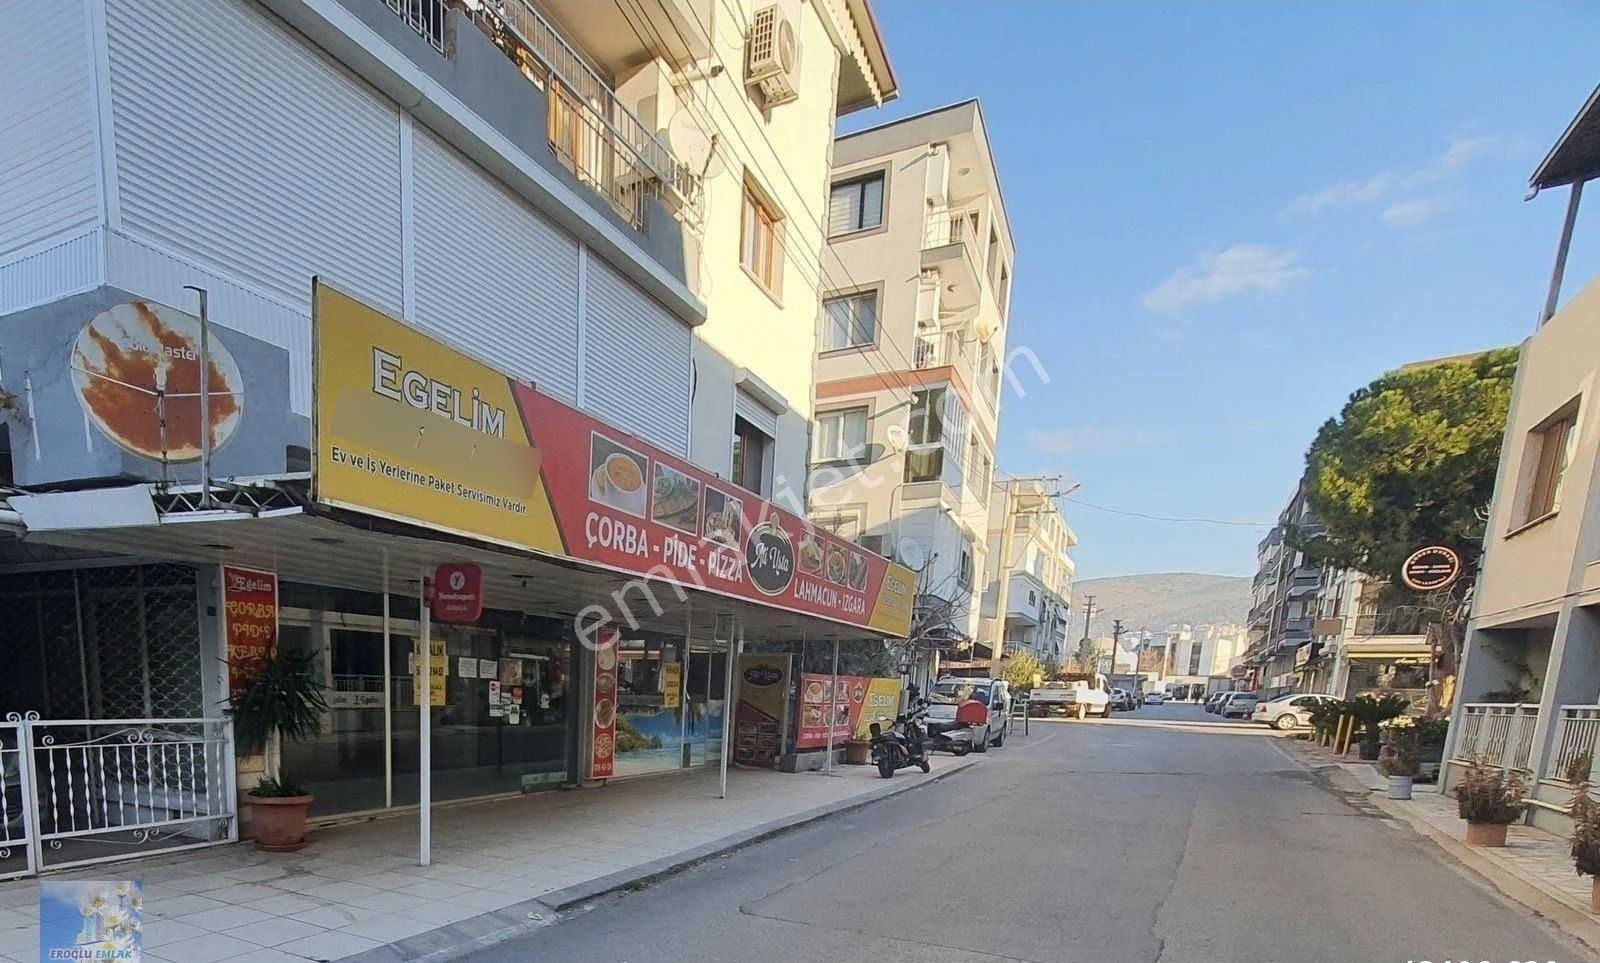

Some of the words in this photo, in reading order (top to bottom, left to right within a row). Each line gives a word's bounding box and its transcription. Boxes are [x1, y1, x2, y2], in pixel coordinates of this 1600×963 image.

[372, 346, 506, 439] EGELİM
[331, 446, 347, 463] Ev
[350, 454, 364, 469] ve
[366, 453, 376, 474] İş
[379, 460, 426, 486] Yerlerine
[428, 475, 456, 494] Paket
[457, 484, 501, 506] Servisimiz
[502, 497, 528, 516] Vardır.
[585, 511, 649, 558] ÇORBA
[663, 533, 698, 571] PİDE
[707, 547, 743, 584] PİZZA
[769, 546, 790, 577] Usta
[793, 578, 838, 609] LAHMACUN
[841, 594, 866, 616] IZGARA
